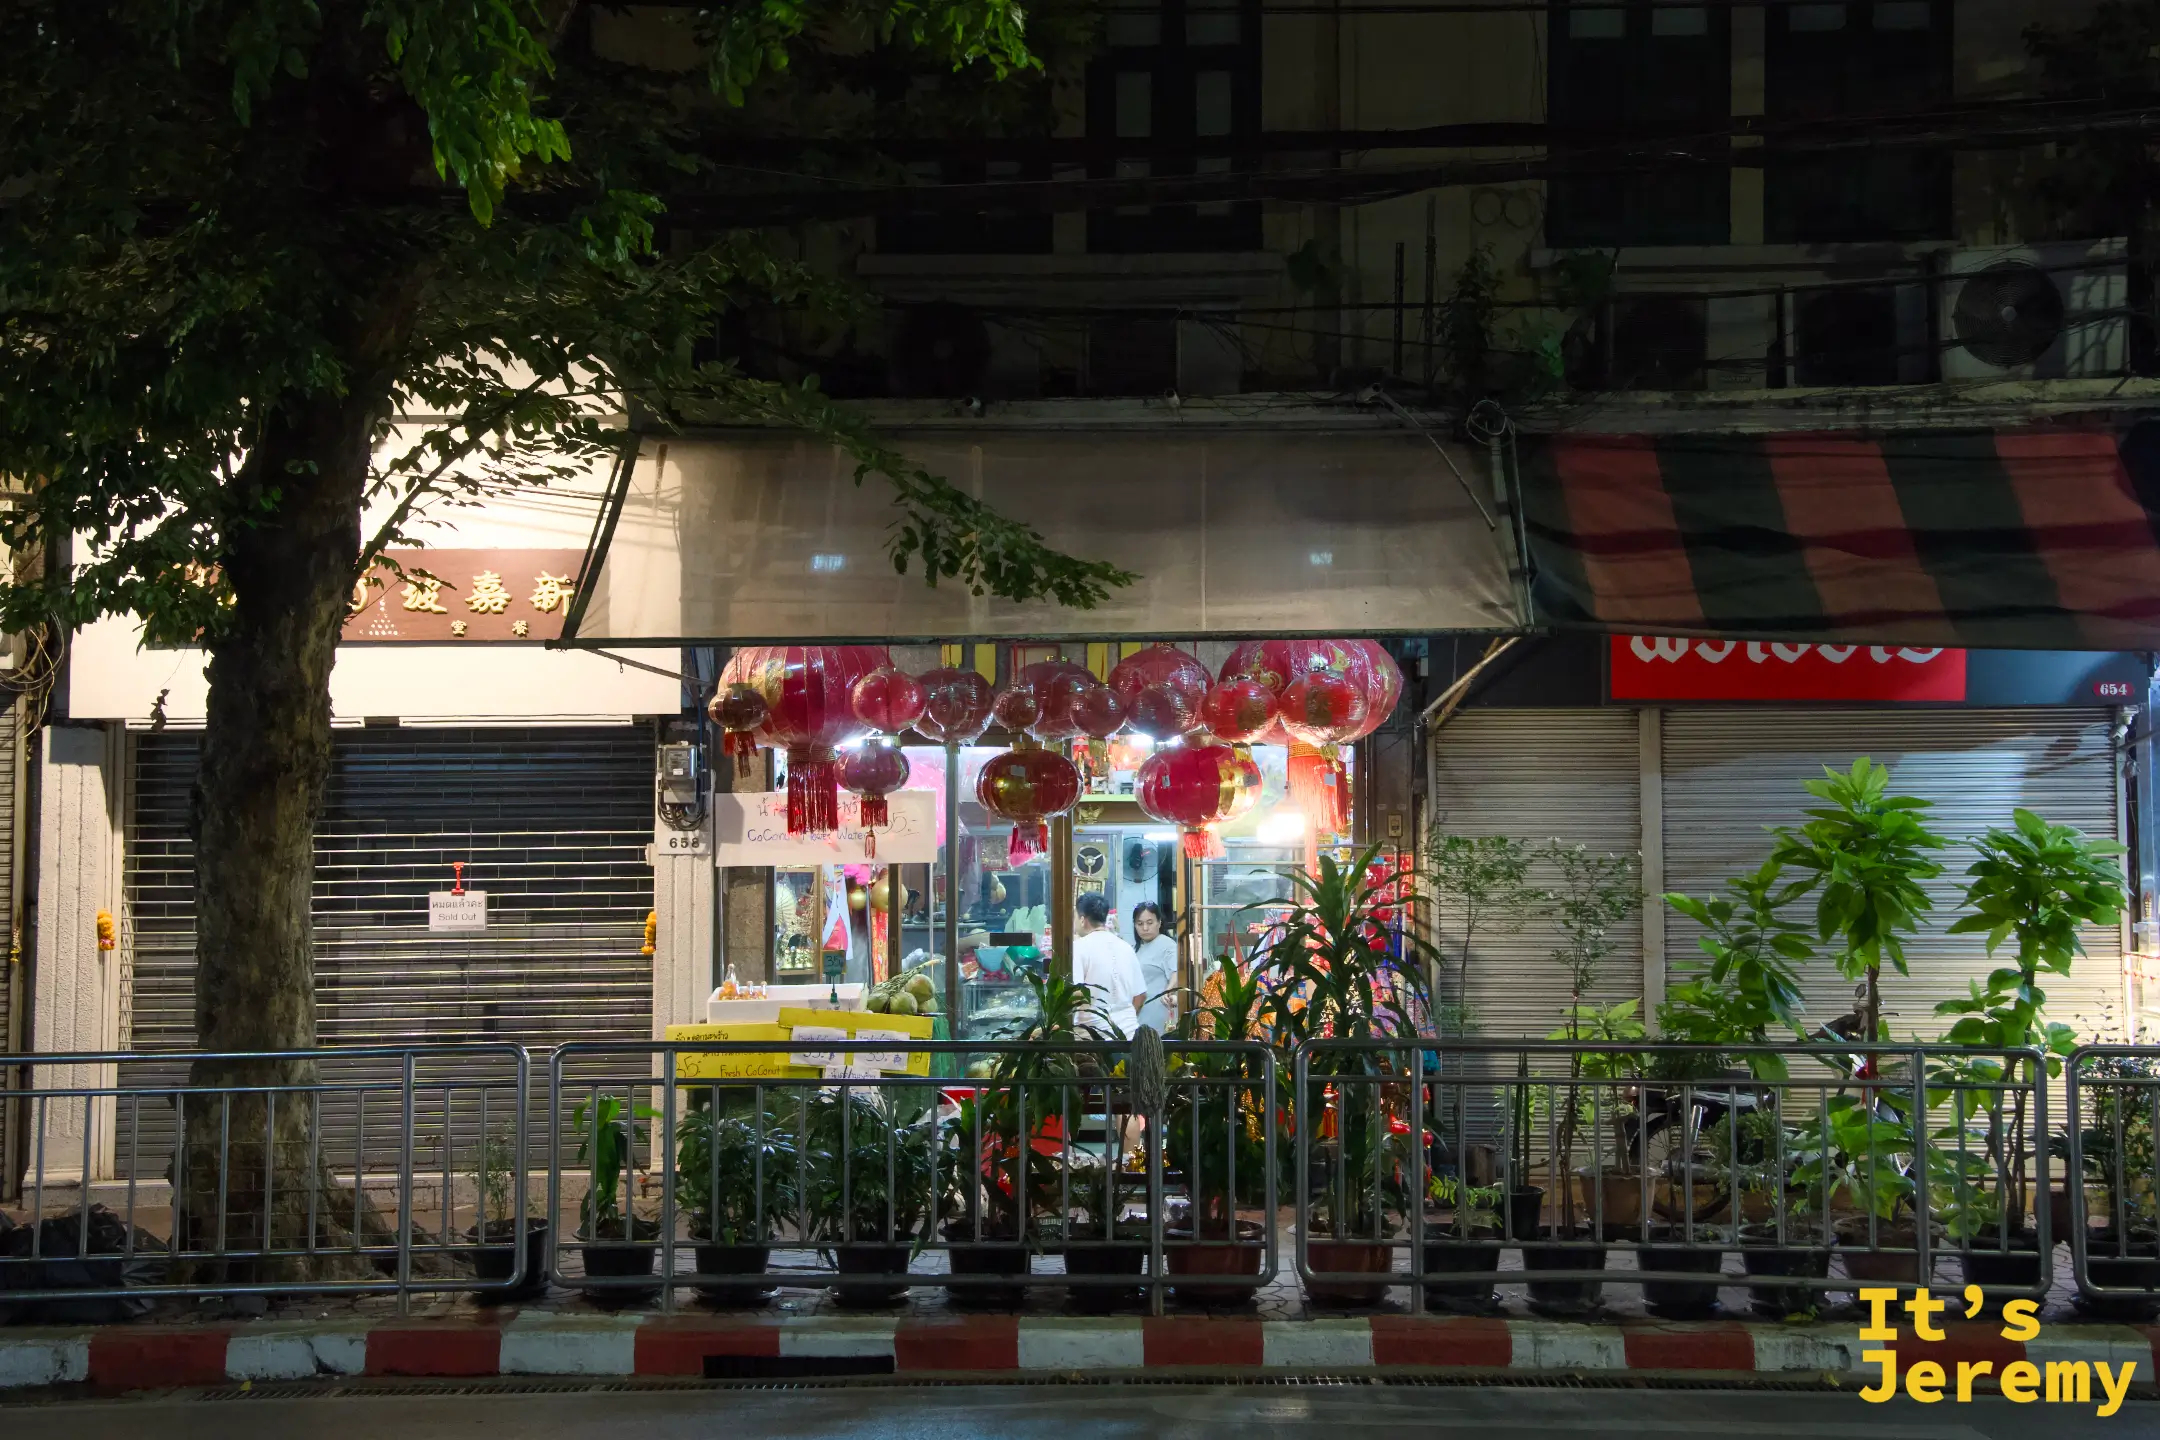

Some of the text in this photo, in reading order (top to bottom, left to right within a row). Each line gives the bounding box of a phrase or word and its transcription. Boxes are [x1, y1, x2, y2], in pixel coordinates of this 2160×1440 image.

[2100, 683, 2128, 696] 654
[747, 828, 793, 842] CoConu
[669, 837, 700, 849] 658
[438, 913, 477, 921] Sold Out
[720, 1064, 741, 1078] Fresh
